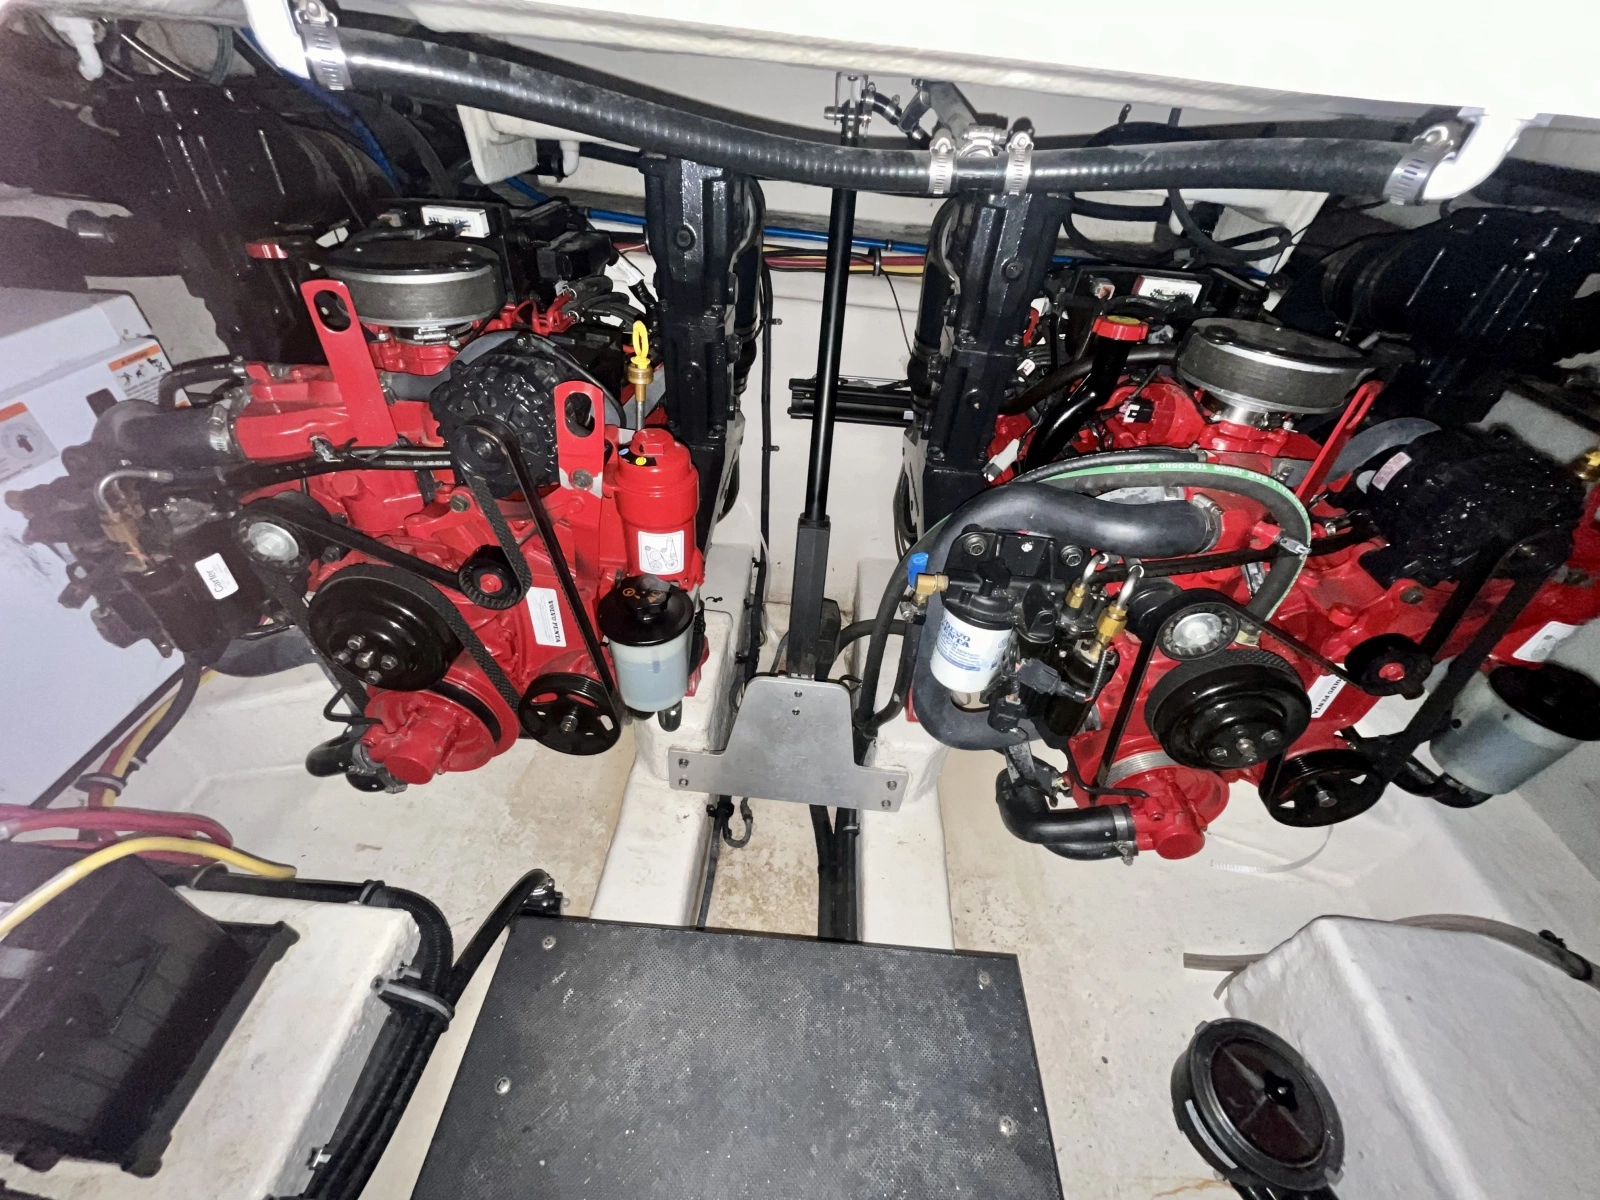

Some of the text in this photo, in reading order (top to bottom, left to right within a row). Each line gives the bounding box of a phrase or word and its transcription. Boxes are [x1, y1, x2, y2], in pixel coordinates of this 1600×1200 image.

[1214, 465, 1245, 475] J2006
[1247, 472, 1269, 483] SAE
[206, 569, 224, 593] Carter
[548, 600, 561, 643] VOLVO PENTA
[1312, 679, 1342, 714] OLVO PENTA
